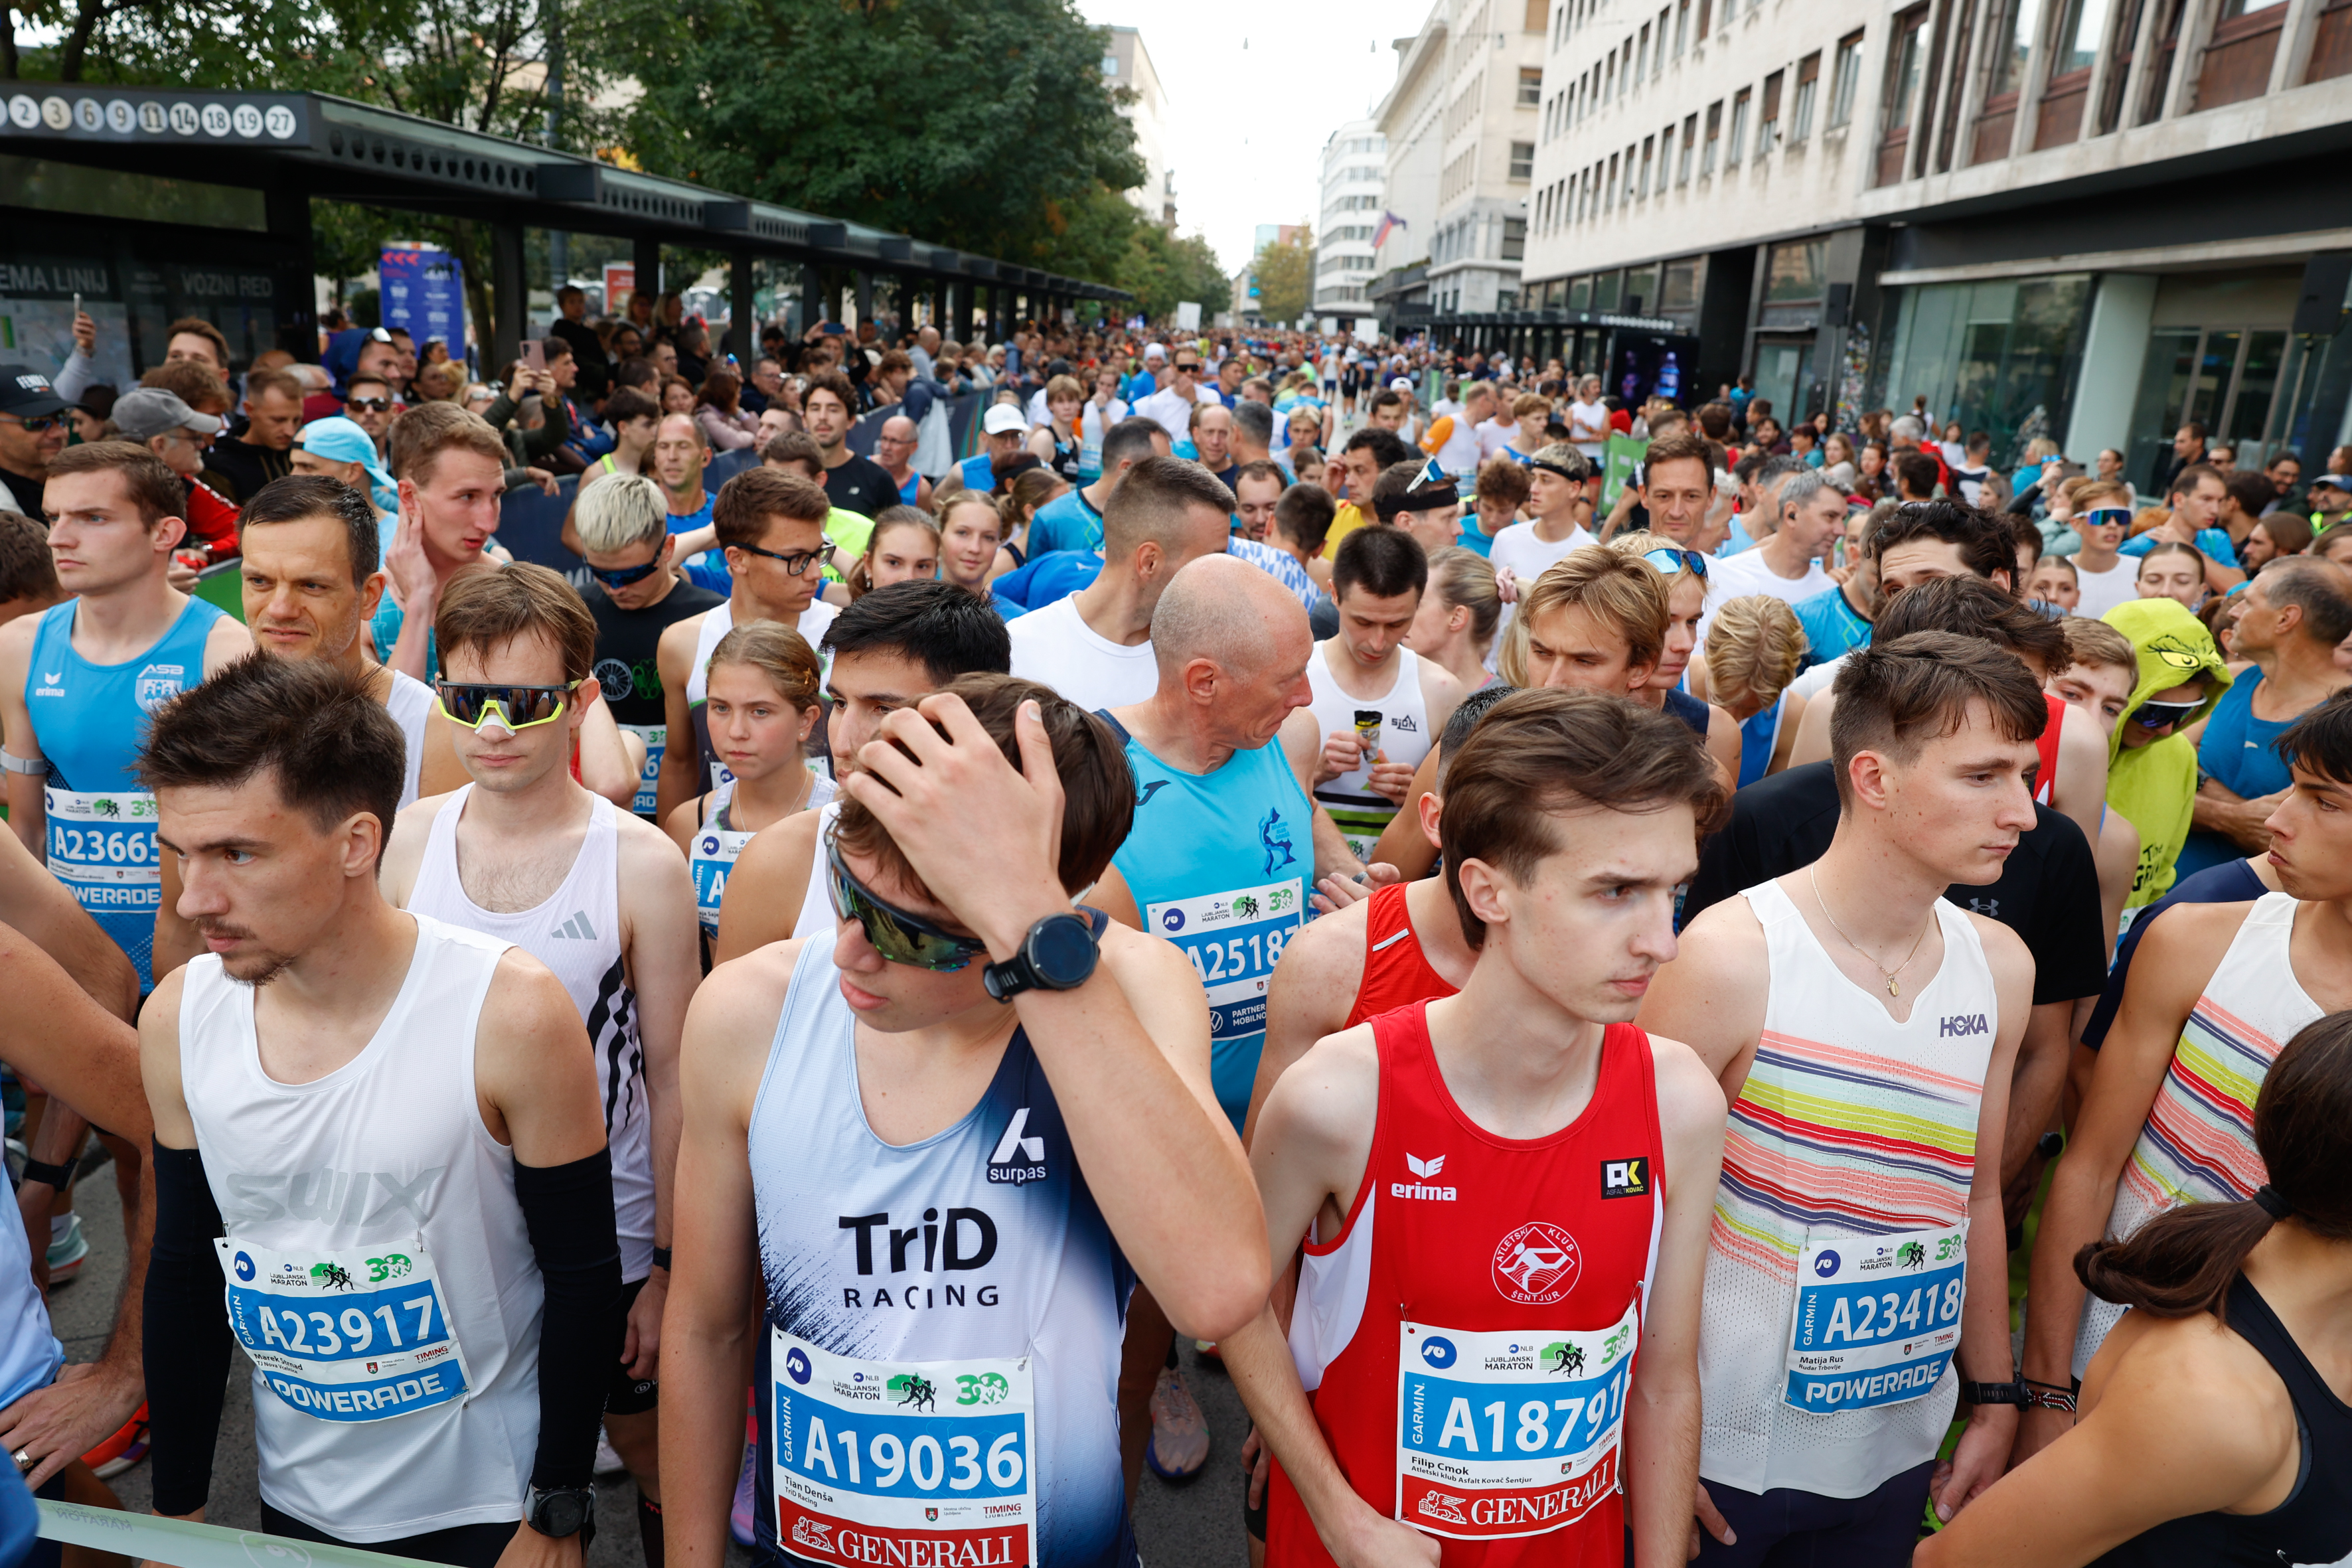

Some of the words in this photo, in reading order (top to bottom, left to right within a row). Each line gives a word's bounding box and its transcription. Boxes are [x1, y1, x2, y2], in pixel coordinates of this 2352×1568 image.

[18, 102, 31, 121] 2
[50, 102, 62, 124] 3
[84, 102, 95, 125] 6
[115, 106, 126, 127] 9
[143, 105, 161, 127] 11
[175, 108, 195, 129] 14
[207, 112, 226, 129] 18
[239, 112, 257, 130] 19
[271, 113, 289, 131] 27
[53, 268, 108, 293] LINIJ
[181, 272, 236, 295] VOZNI
[238, 275, 274, 297] RED
[137, 664, 185, 678] ASB
[35, 686, 65, 697] erima
[64, 883, 160, 904] WERADE
[1202, 909, 1229, 917] LJUBLJANSKI
[1202, 913, 1230, 923] MARATON
[1232, 1003, 1266, 1018] PARTNER
[1233, 1012, 1266, 1027] MOBILNO
[1940, 1014, 1989, 1038] HOKA
[990, 1166, 1046, 1183] surpas
[222, 1166, 447, 1227] SWIX
[1391, 1182, 1456, 1201] erima
[839, 1207, 998, 1275] TriD
[1496, 1227, 1529, 1263] ATLETSKI
[1547, 1228, 1575, 1252] KLUB
[1859, 1261, 1892, 1271] MARATON
[271, 1278, 307, 1287] MARATON
[843, 1285, 998, 1310] RACING
[1511, 1290, 1560, 1302] ŠENTJUR
[232, 1294, 254, 1345] GARMIN
[1803, 1294, 1817, 1346] GARMIN
[1823, 1278, 1960, 1344] A23418
[258, 1294, 433, 1355] A23917
[1934, 1332, 1954, 1343] TIMING
[1934, 1338, 1954, 1347] LJUBLJANA
[254, 1354, 280, 1362] Marek
[279, 1358, 303, 1370] Strnad
[414, 1346, 448, 1360] TIMING
[418, 1352, 449, 1364] LJUBLJANA
[1800, 1356, 1828, 1366] Matija
[273, 1373, 444, 1412] POWERADE
[832, 1379, 880, 1391] LJUBLJANSKI
[1805, 1360, 1942, 1404] POWERADE
[834, 1386, 880, 1400] MARATON
[1412, 1383, 1425, 1445] GARMIN
[1438, 1370, 1622, 1452] A18791
[1599, 1427, 1616, 1449] TIMING
[803, 1415, 1023, 1490] A19036
[1411, 1456, 1435, 1469] Filip
[1437, 1462, 1470, 1475] Cmok
[1411, 1466, 1439, 1477] Atletski
[1441, 1472, 1456, 1482] klub
[1505, 1476, 1532, 1485] Šentjur
[785, 1475, 803, 1491] Tian
[805, 1484, 834, 1503] Denša
[785, 1486, 797, 1496] TriD
[798, 1492, 817, 1508] Racing
[1471, 1460, 1609, 1525] GENERALI
[983, 1503, 1022, 1514] TIMING
[838, 1529, 1013, 1568] GENERALI
